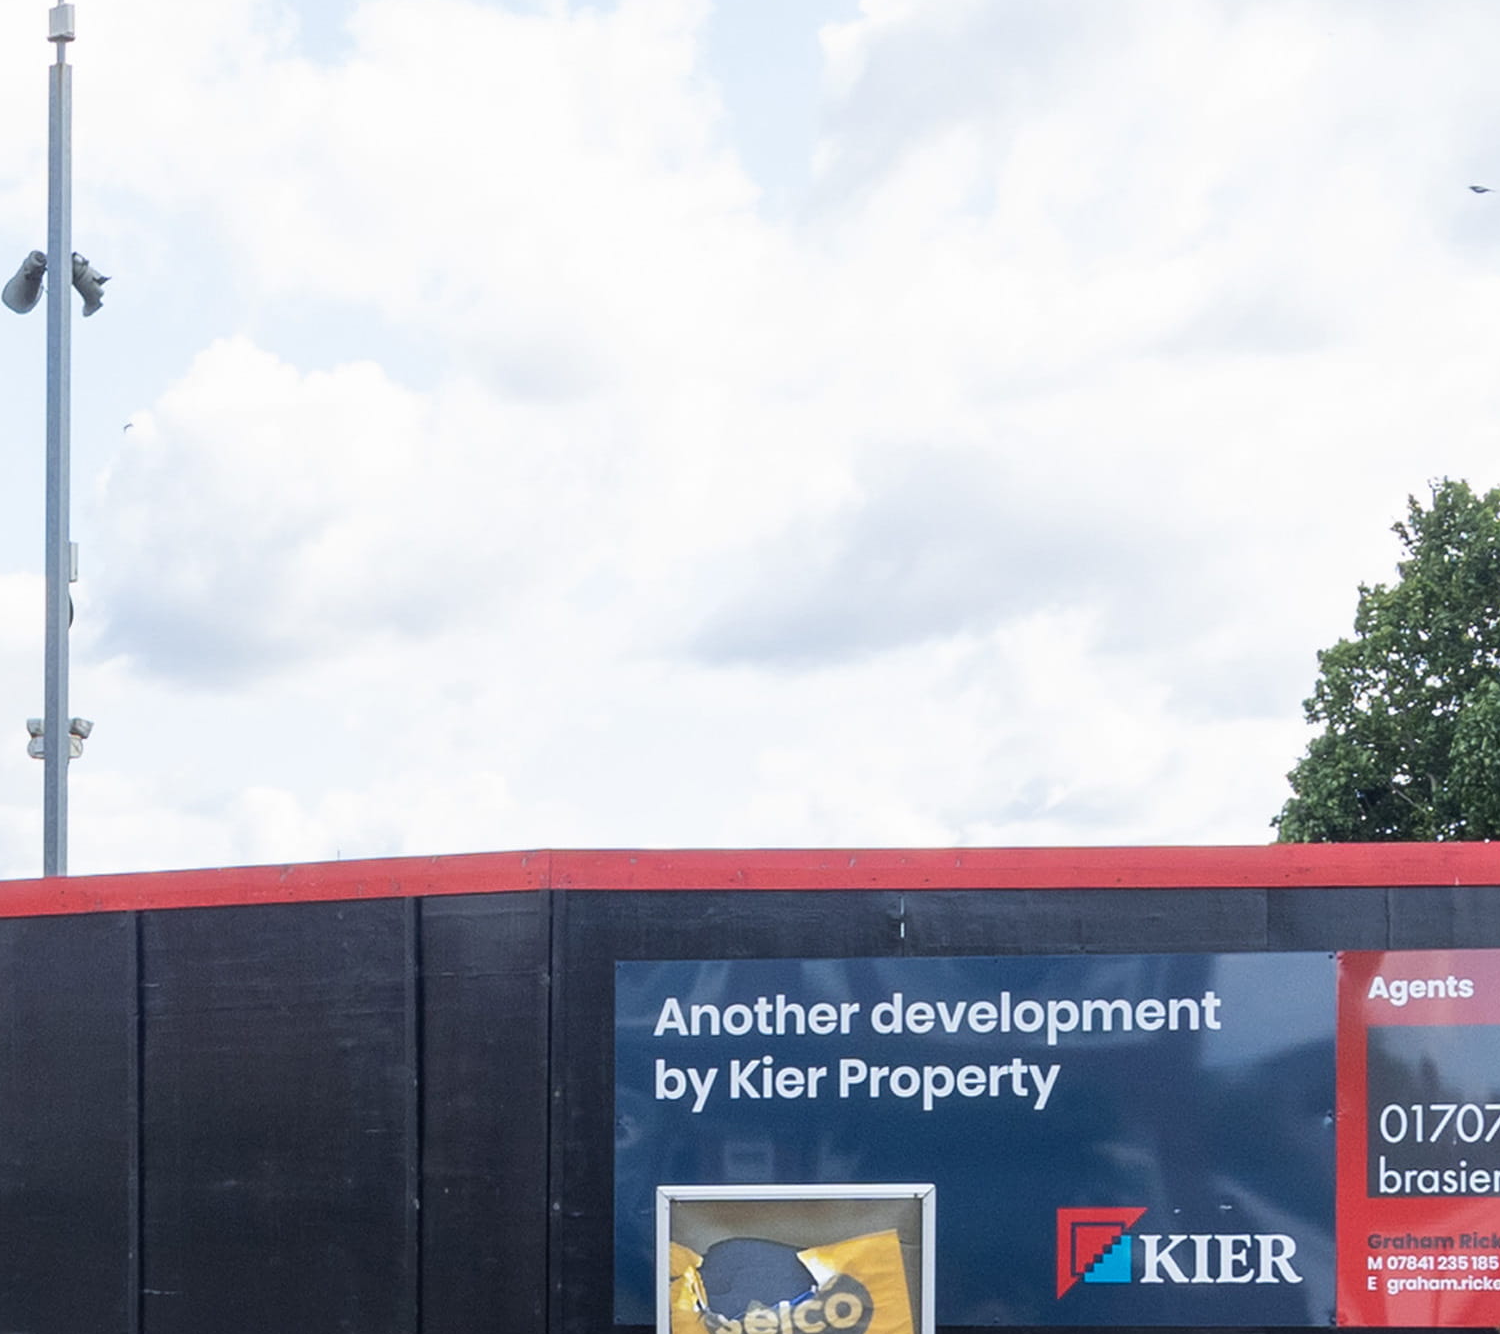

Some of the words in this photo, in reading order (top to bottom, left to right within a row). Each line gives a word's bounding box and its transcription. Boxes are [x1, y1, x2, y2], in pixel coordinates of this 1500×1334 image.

[1368, 975, 1474, 1006] Agents
[653, 994, 860, 1036] Another
[870, 990, 1222, 1045] development
[655, 1059, 717, 1113] by
[729, 1056, 828, 1099] Kier
[839, 1058, 1061, 1111] Property
[1367, 1233, 1454, 1250] Graham
[1138, 1232, 1303, 1285] KIER
[1367, 1256, 1383, 1270] M
[1387, 1255, 1435, 1270] 07841
[1437, 1255, 1469, 1270] 235
[1471, 1255, 1500, 1270] 185
[1367, 1277, 1377, 1291] E
